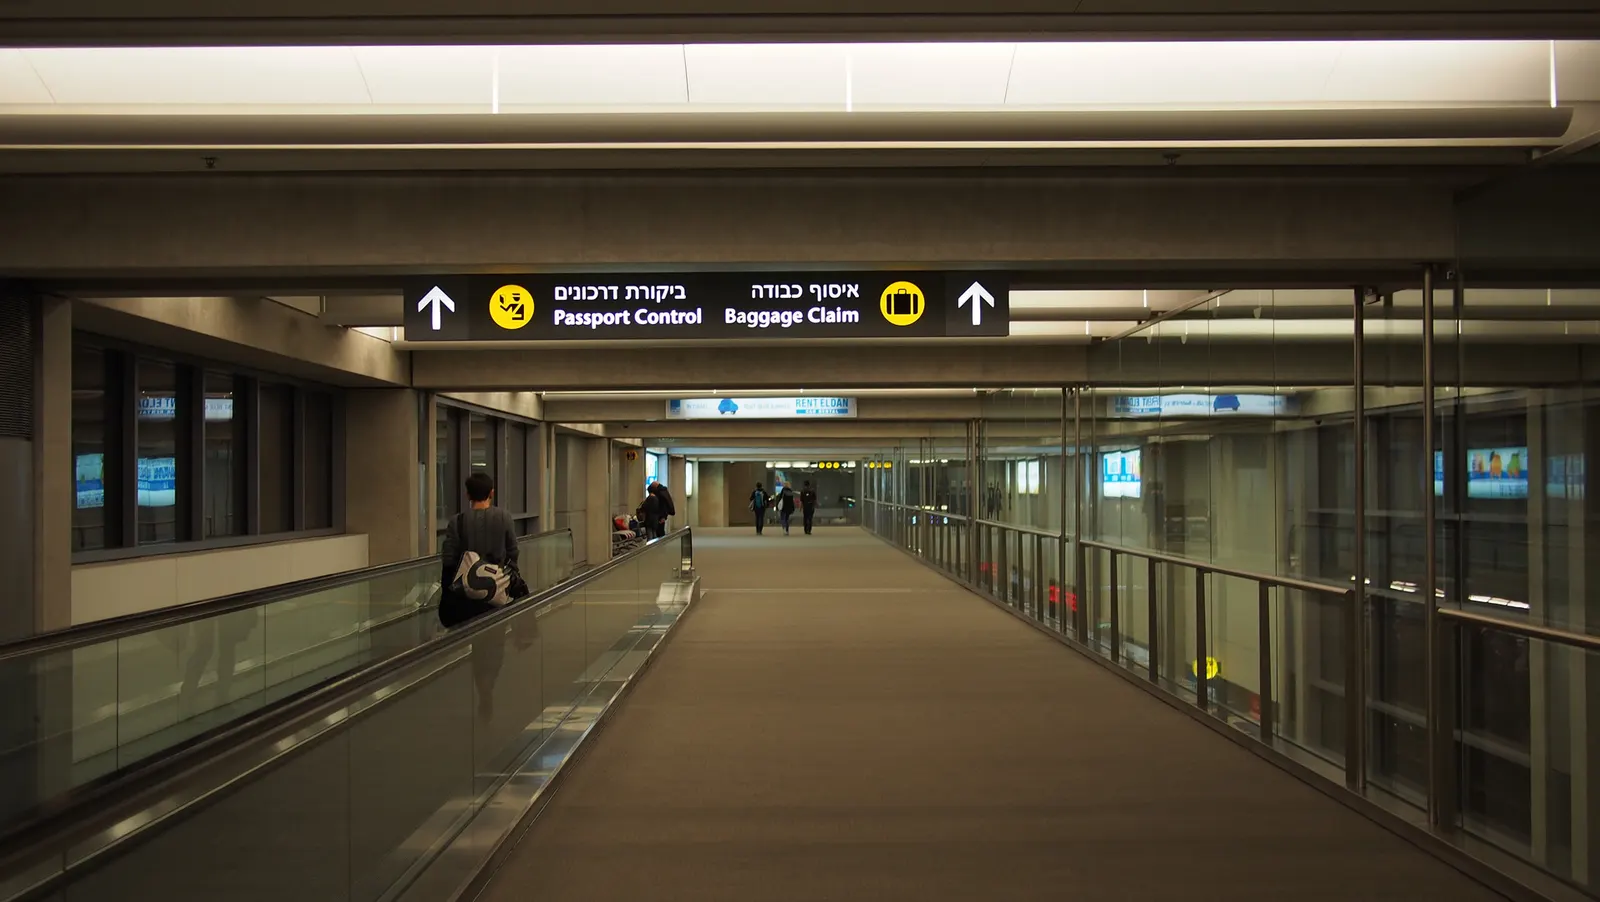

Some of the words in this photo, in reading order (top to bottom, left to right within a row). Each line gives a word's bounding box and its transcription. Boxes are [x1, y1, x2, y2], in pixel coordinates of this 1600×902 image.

[554, 285, 618, 301] דרכונים
[625, 285, 686, 303] ביקורת
[752, 284, 802, 299] כבודה
[810, 283, 859, 301] איסוף
[554, 309, 631, 329] Passport
[635, 308, 702, 325] Control
[725, 308, 803, 328] Baggage
[808, 307, 859, 324] Claim
[796, 398, 818, 408] RENT
[820, 398, 849, 408] ELDAN
